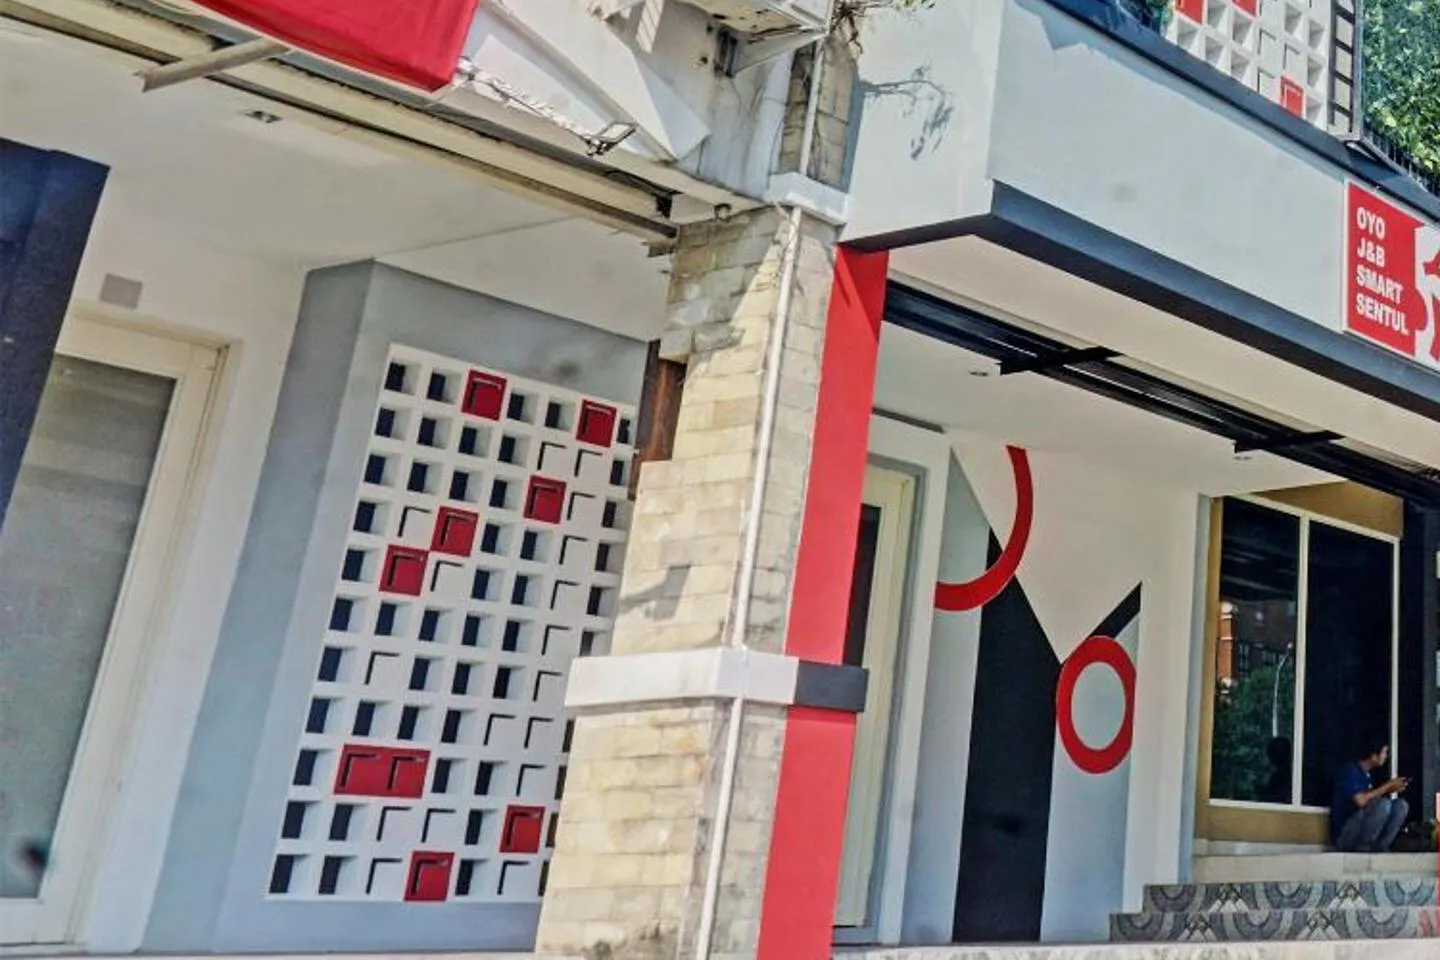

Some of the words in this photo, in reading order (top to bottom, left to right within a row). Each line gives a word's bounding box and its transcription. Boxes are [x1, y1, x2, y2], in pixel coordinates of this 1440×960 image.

[1357, 207, 1385, 238] OYO
[1357, 240, 1385, 267] J&B
[1356, 266, 1403, 303] SMART
[1356, 293, 1409, 335] SENTUL
